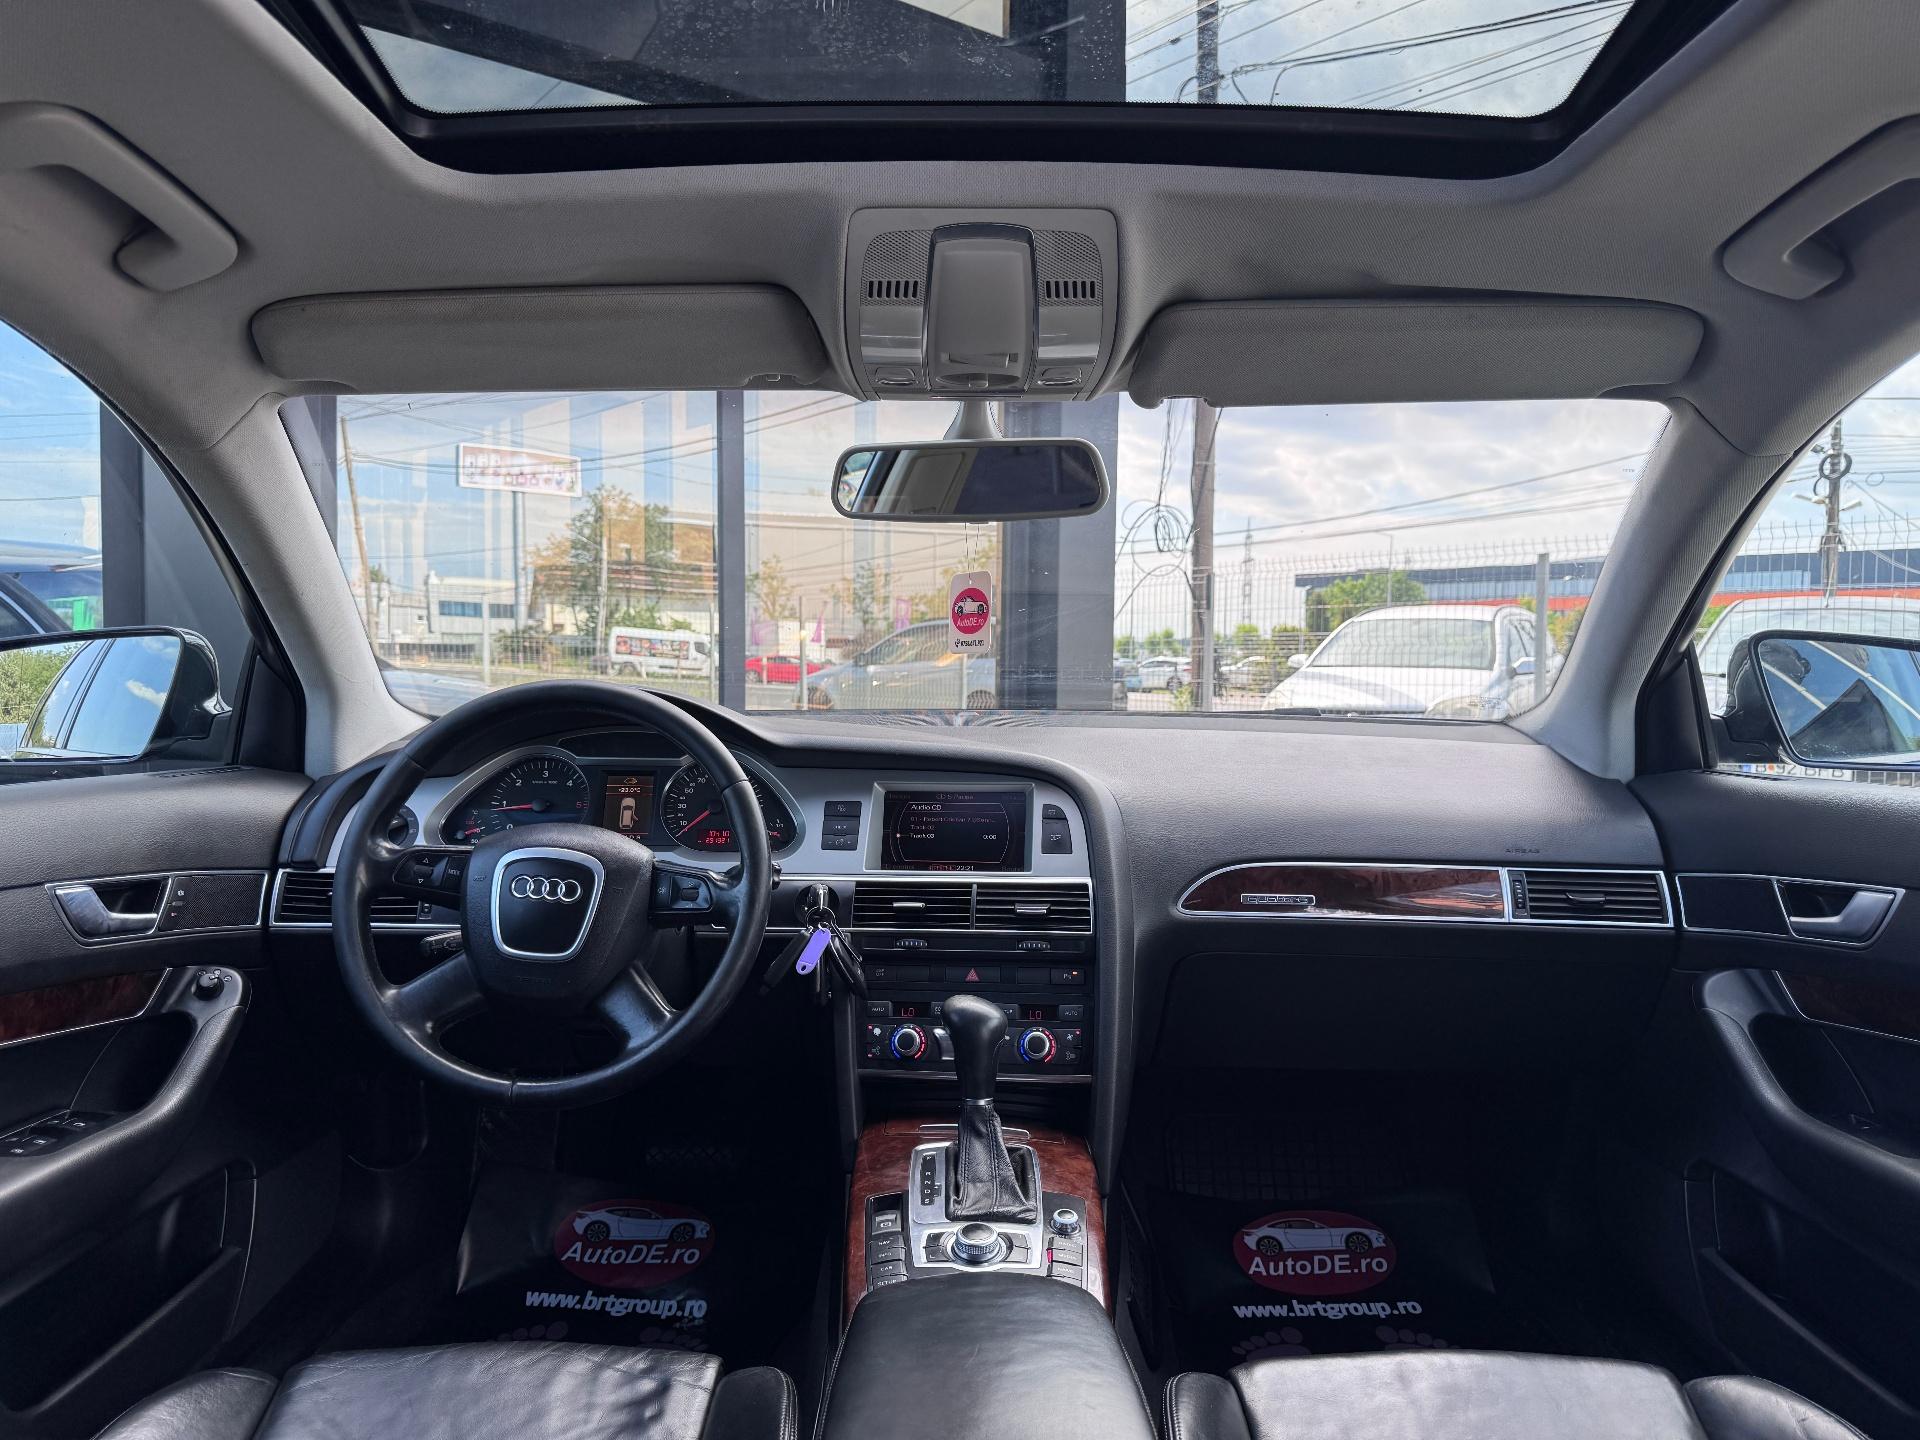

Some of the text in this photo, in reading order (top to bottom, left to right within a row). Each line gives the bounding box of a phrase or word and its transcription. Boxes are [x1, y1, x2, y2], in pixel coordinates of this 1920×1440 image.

[566, 779, 573, 787] 4
[561, 1241, 700, 1265] AutoDE.ro
[1248, 1254, 1388, 1276] AutoDE.ro
[526, 1290, 708, 1319] www.brtgroup.ro
[1233, 1299, 1422, 1320] www.brtgroup.ro
